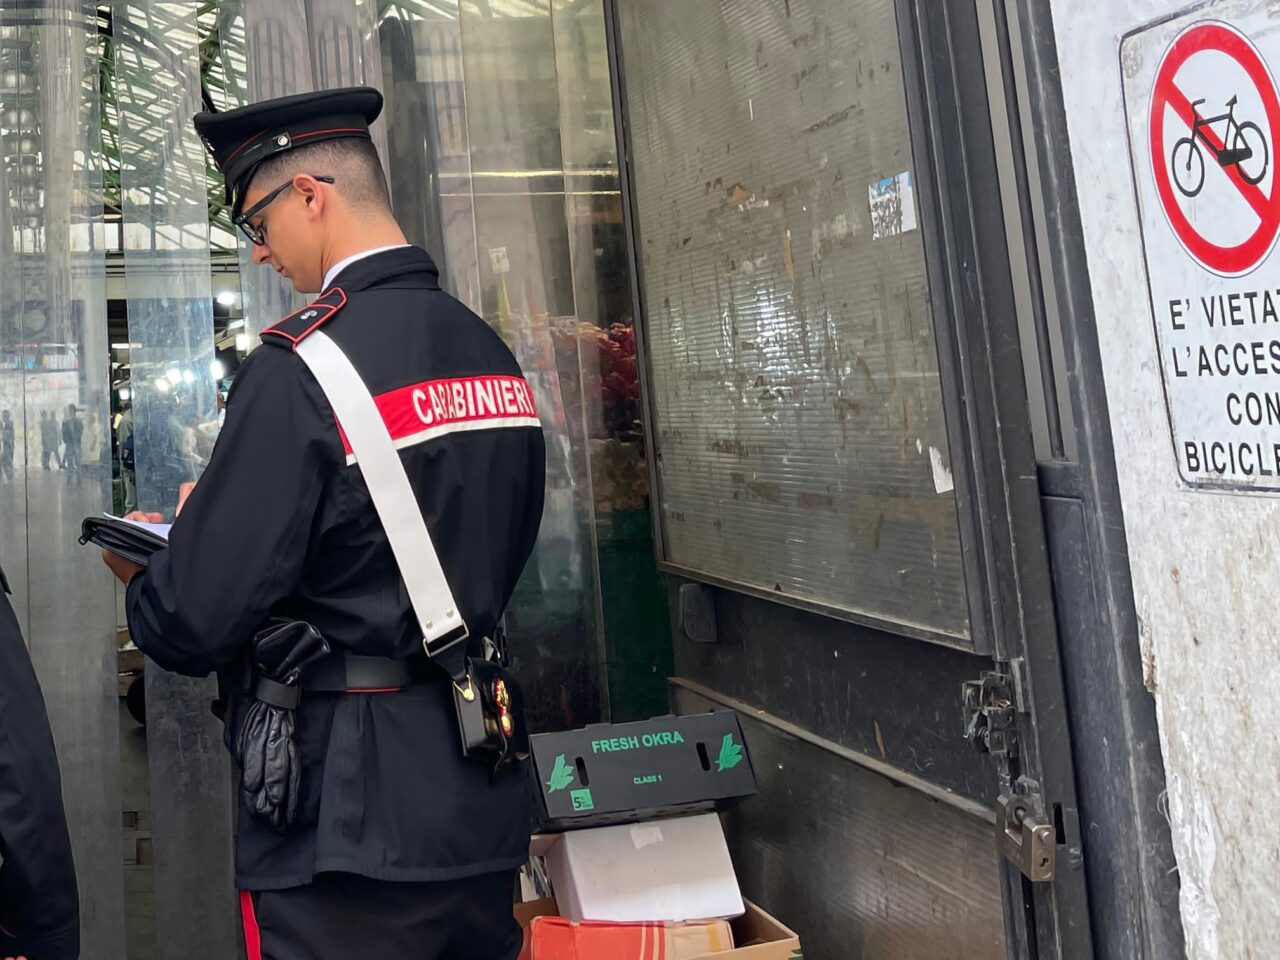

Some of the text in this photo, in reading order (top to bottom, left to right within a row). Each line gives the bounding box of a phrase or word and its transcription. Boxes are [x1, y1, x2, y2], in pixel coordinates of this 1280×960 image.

[1201, 289, 1280, 328] VIETA
[1226, 392, 1280, 426] CON
[591, 731, 684, 753] FRESH OKRA
[573, 796, 582, 809] 5
